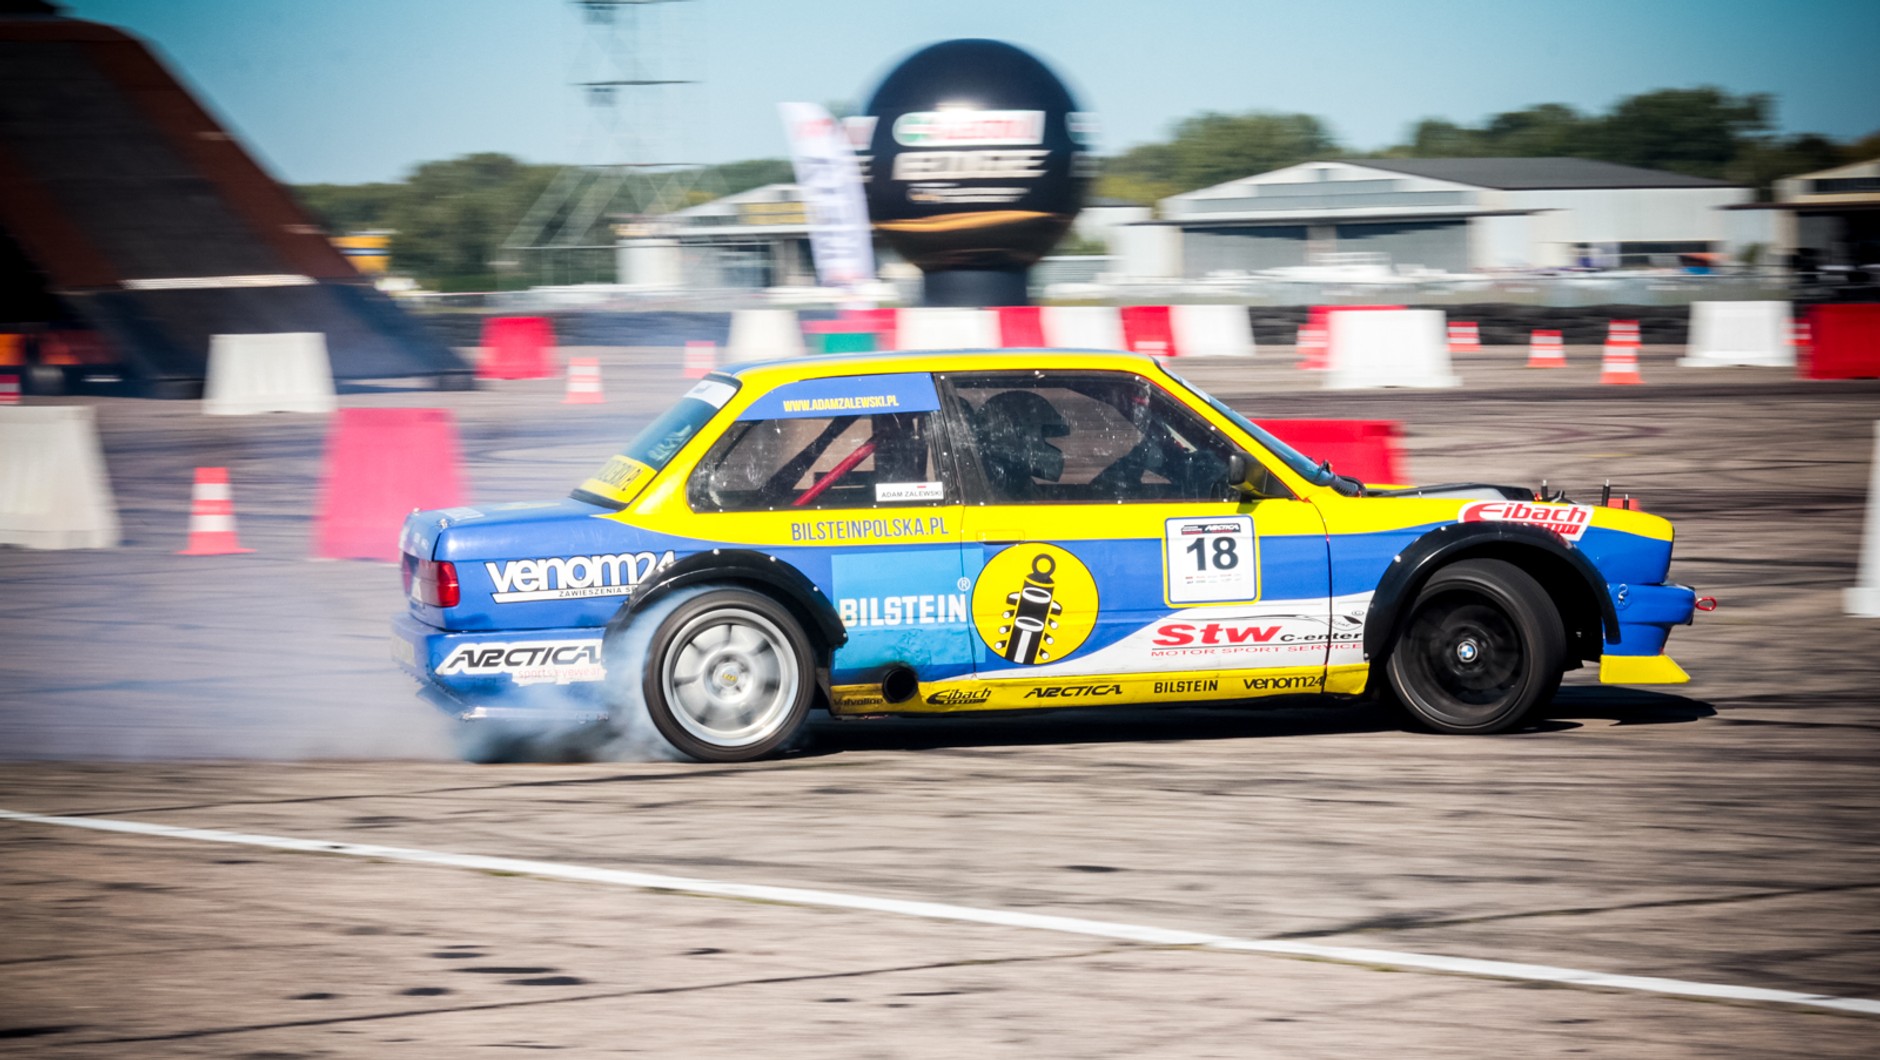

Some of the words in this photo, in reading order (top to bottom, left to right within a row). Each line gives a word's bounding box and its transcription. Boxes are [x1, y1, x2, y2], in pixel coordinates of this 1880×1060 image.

[783, 395, 899, 412] WWW.ADAMZALEWSKI.PL
[1463, 503, 1588, 524] Eibach
[791, 517, 949, 541] BILSTEINPOLSKA.PL
[1186, 536, 1239, 571] 18
[559, 586, 622, 598] ZAWIESZENIA
[839, 594, 968, 628] BILSTEIN
[1152, 623, 1282, 646] Stw
[447, 645, 602, 669] ARCTICA
[1151, 648, 1214, 657] MOTOR
[1222, 646, 1279, 654] SPORT
[1287, 643, 1362, 652] SERVICE
[1024, 685, 1123, 698] ARCTICA
[1154, 680, 1218, 694] BILSTEIN
[1244, 676, 1325, 690] venom24
[926, 687, 992, 704] Eibach
